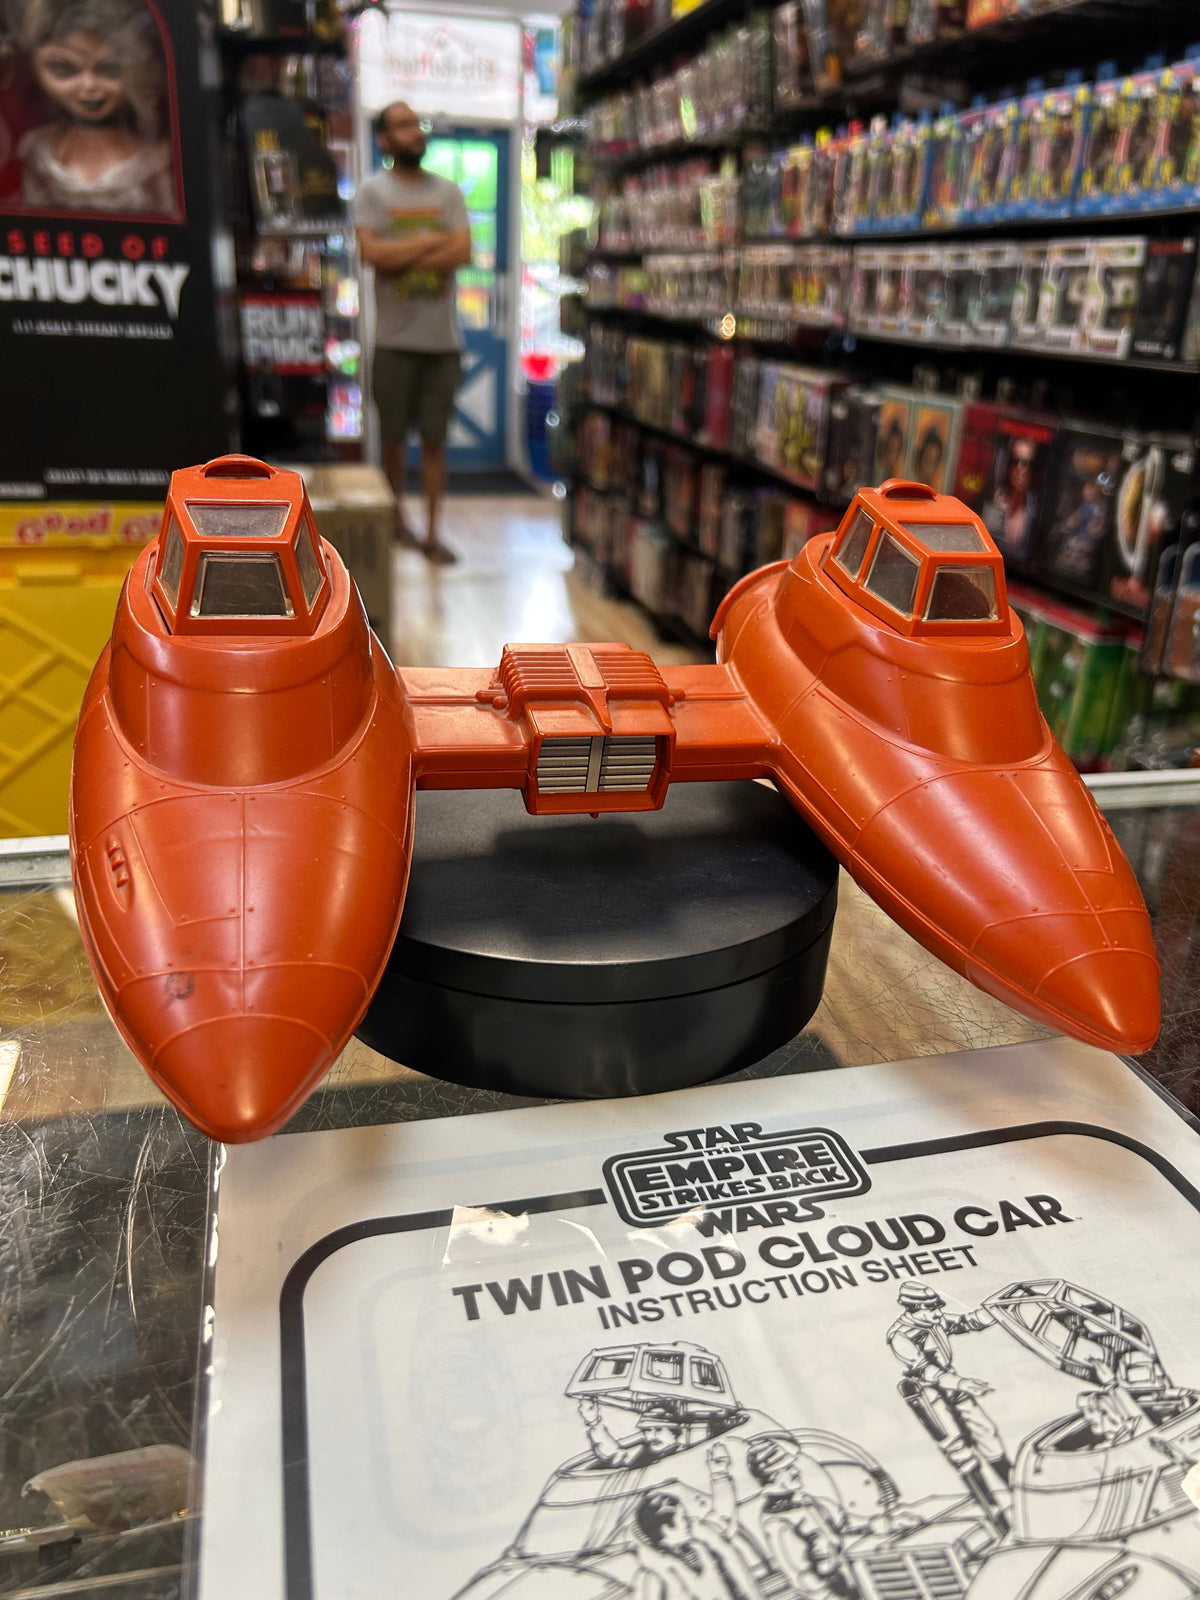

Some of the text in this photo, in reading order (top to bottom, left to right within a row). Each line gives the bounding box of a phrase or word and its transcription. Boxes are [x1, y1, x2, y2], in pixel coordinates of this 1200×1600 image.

[7, 229, 169, 261] SEED OF
[663, 1121, 764, 1150] STAR
[627, 1143, 835, 1193] EMPIRE
[638, 1165, 846, 1210] STRIKES BACK
[695, 1200, 826, 1238] WARS
[451, 1194, 1075, 1322] TWIN POD CLOUD CAR
[597, 1243, 979, 1330] INSTRUCTION SHEET
